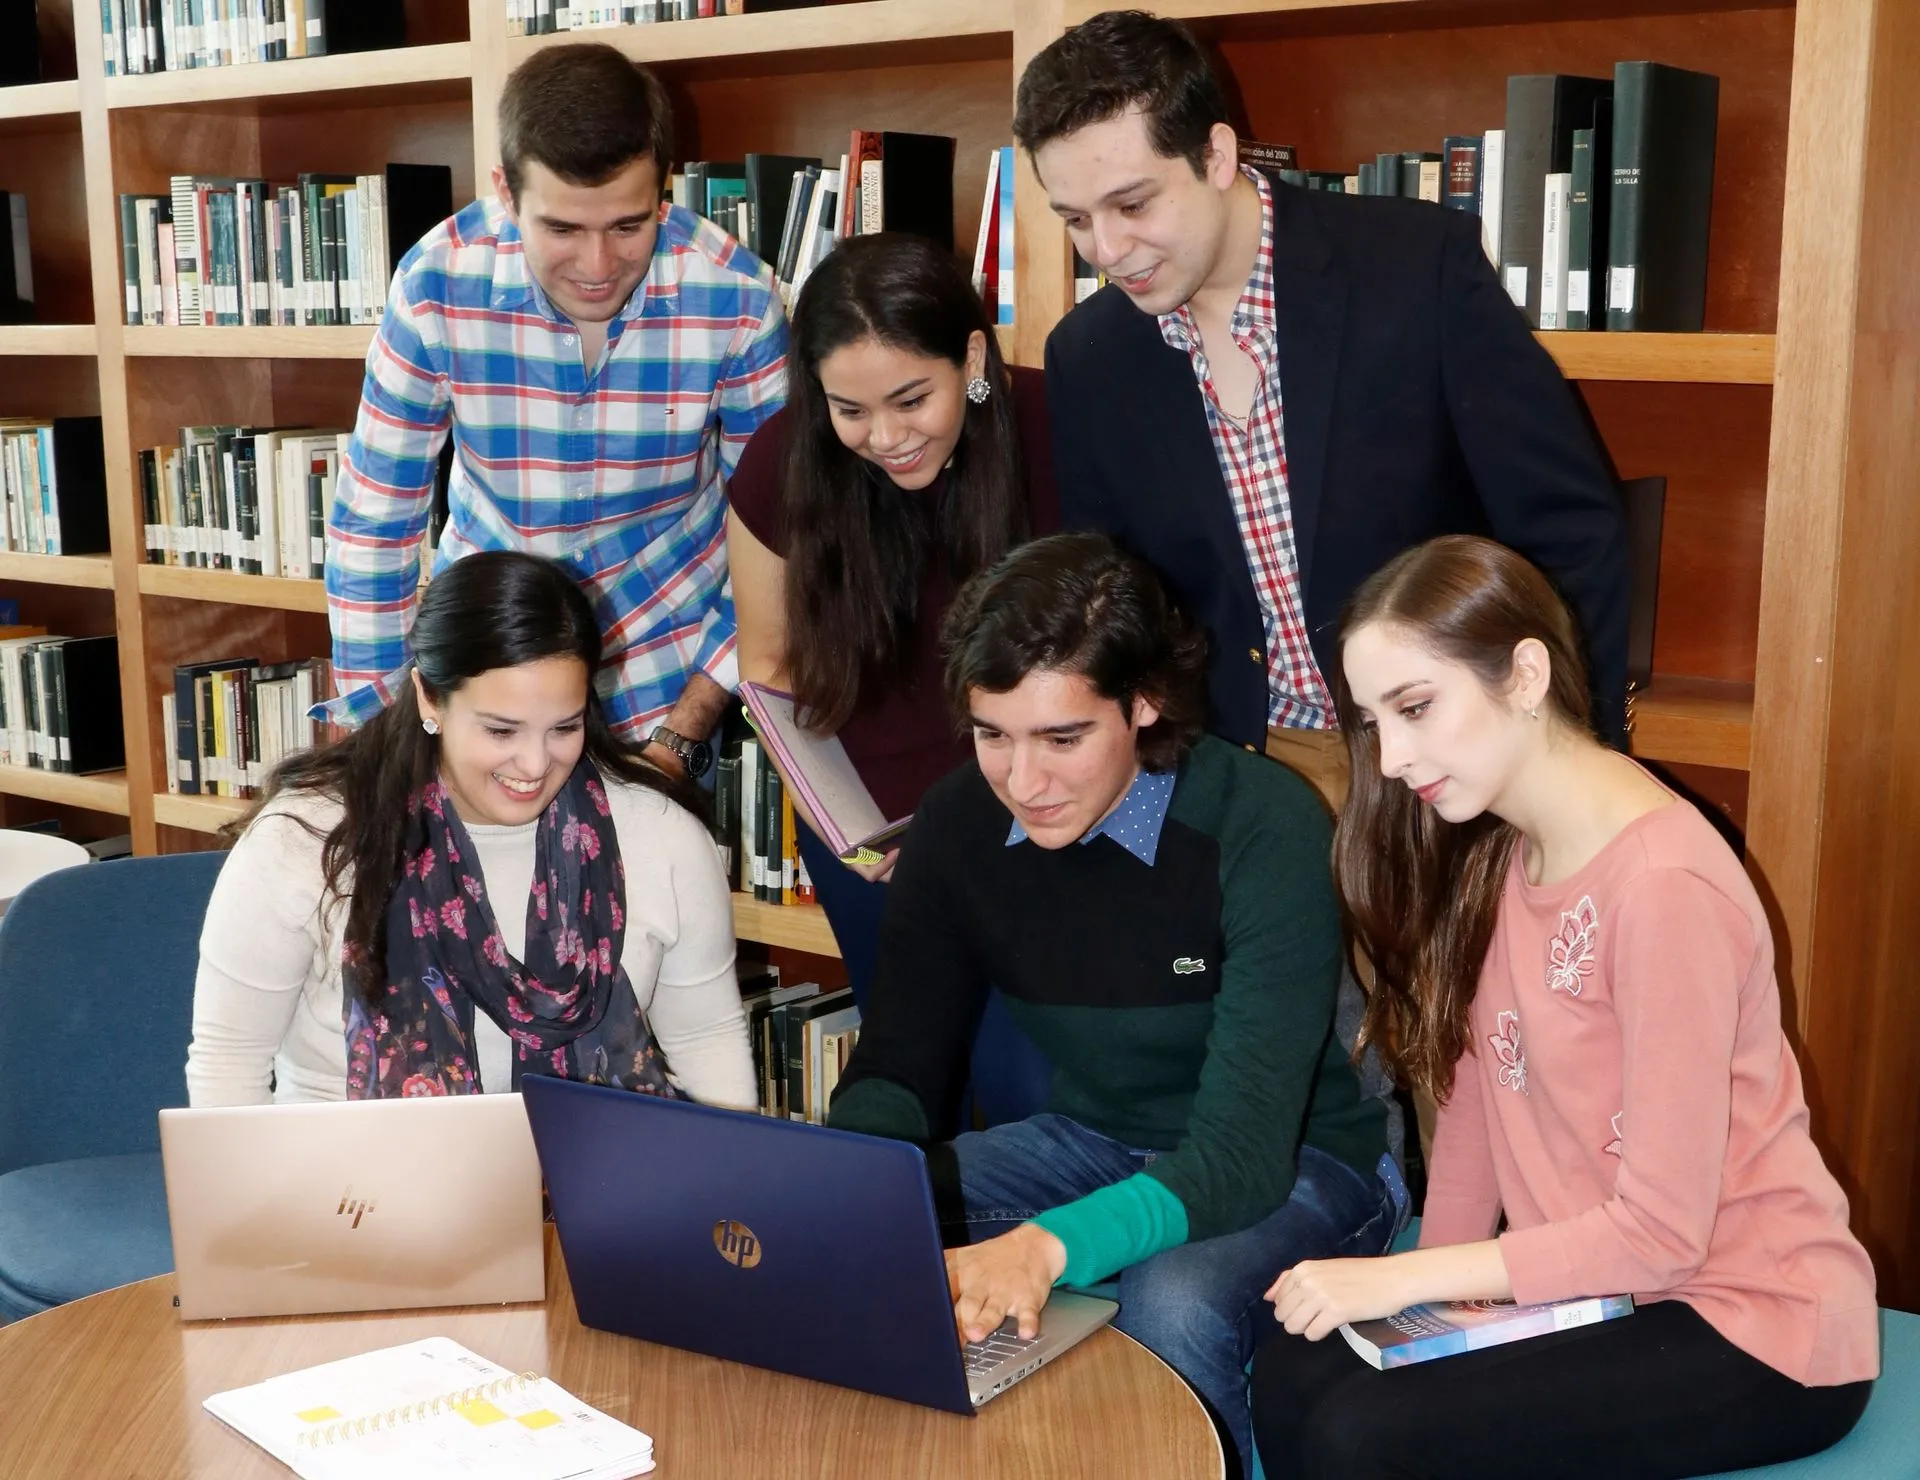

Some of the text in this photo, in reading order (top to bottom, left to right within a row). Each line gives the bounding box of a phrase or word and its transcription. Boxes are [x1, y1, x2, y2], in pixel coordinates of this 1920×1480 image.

[1274, 150, 1289, 160] 2000
[1614, 168, 1630, 176] CERRO
[722, 1221, 754, 1266] hp
